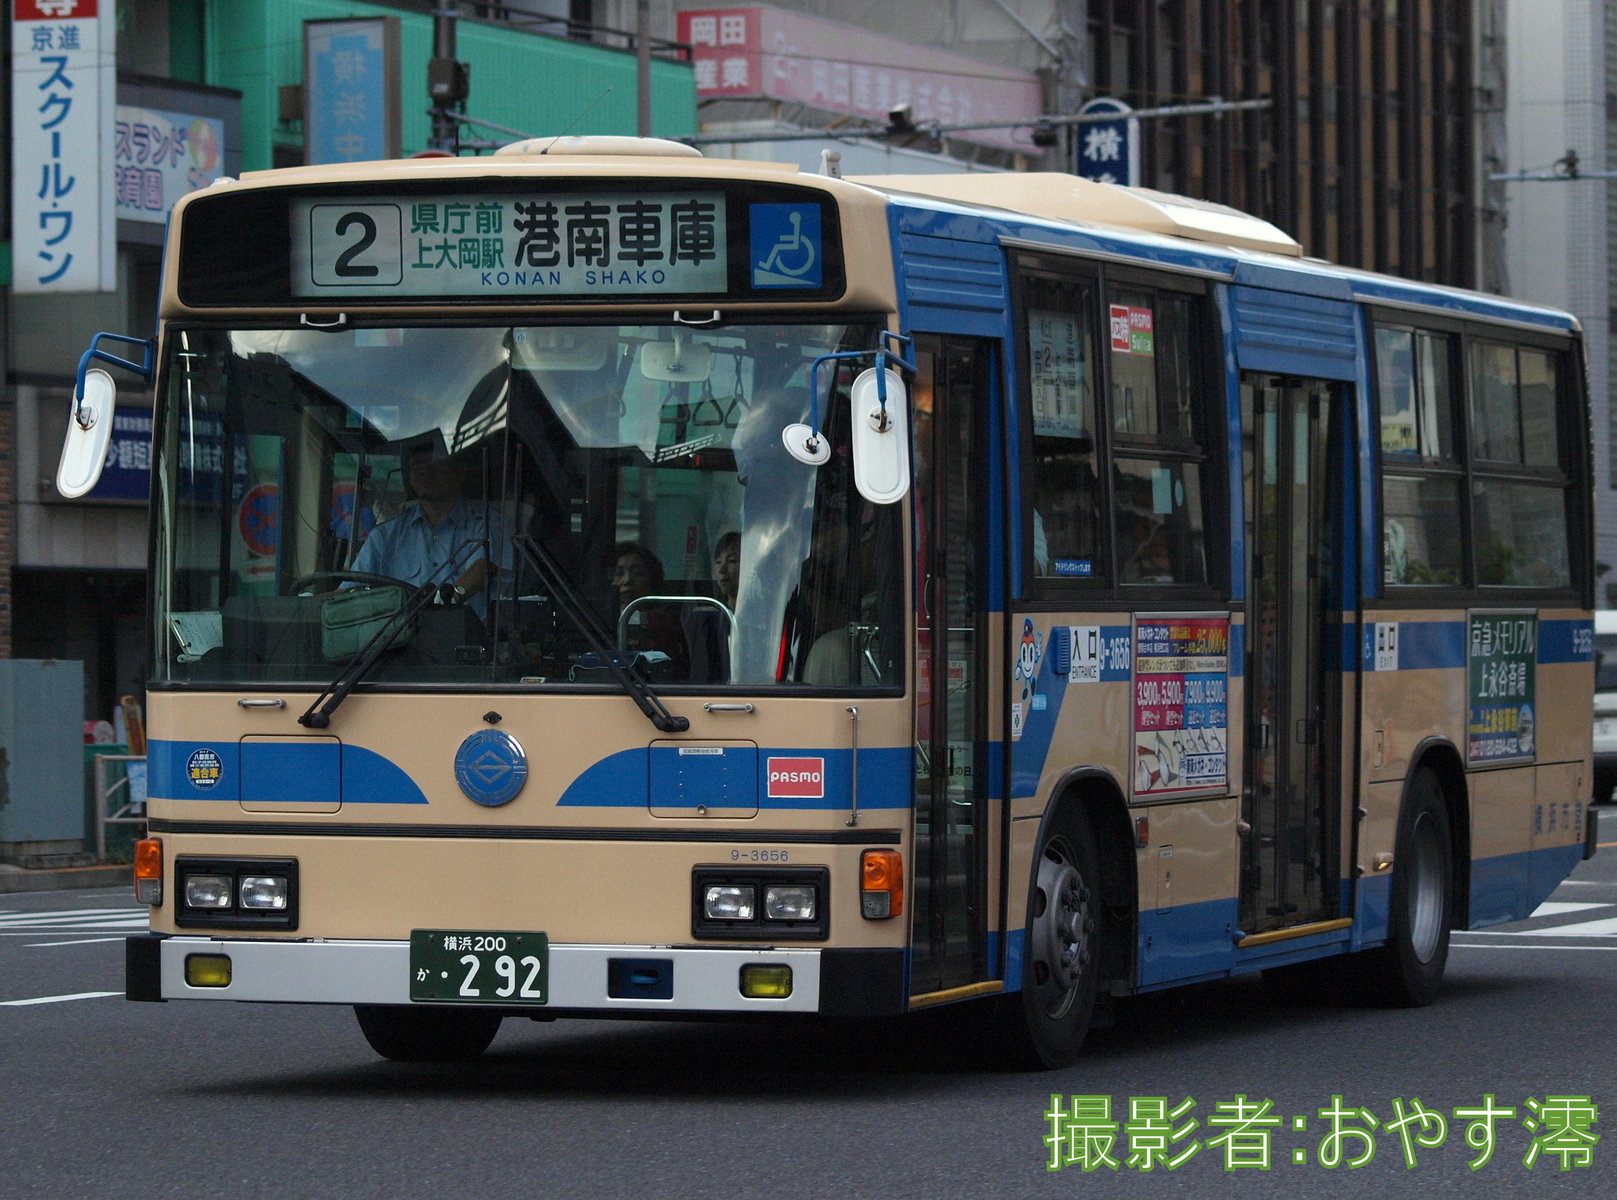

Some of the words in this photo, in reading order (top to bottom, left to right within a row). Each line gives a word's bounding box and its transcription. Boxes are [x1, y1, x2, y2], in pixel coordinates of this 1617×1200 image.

[31, 25, 81, 51] 京進
[691, 16, 745, 47] 岡田
[694, 58, 749, 89] 産業
[38, 55, 75, 285] スクール・ワン
[410, 203, 503, 235] 県庁前
[513, 200, 716, 268] 港南車庫
[335, 212, 379, 278] 2
[411, 237, 505, 270] 上大岡駅
[481, 271, 562, 286] KONAN
[585, 270, 666, 285] SHAKO
[1130, 312, 1151, 329] PASMO
[1131, 334, 1152, 351] Suica
[1072, 629, 1098, 661] 入口
[1099, 637, 1130, 670] 9-3656
[1378, 626, 1395, 652] 出口
[1471, 619, 1534, 657] 京急メモリアル
[1072, 665, 1097, 679] ENTRANCE
[191, 767, 219, 779] 適合車
[770, 771, 821, 783] PASMO
[731, 850, 789, 862] 9-3656
